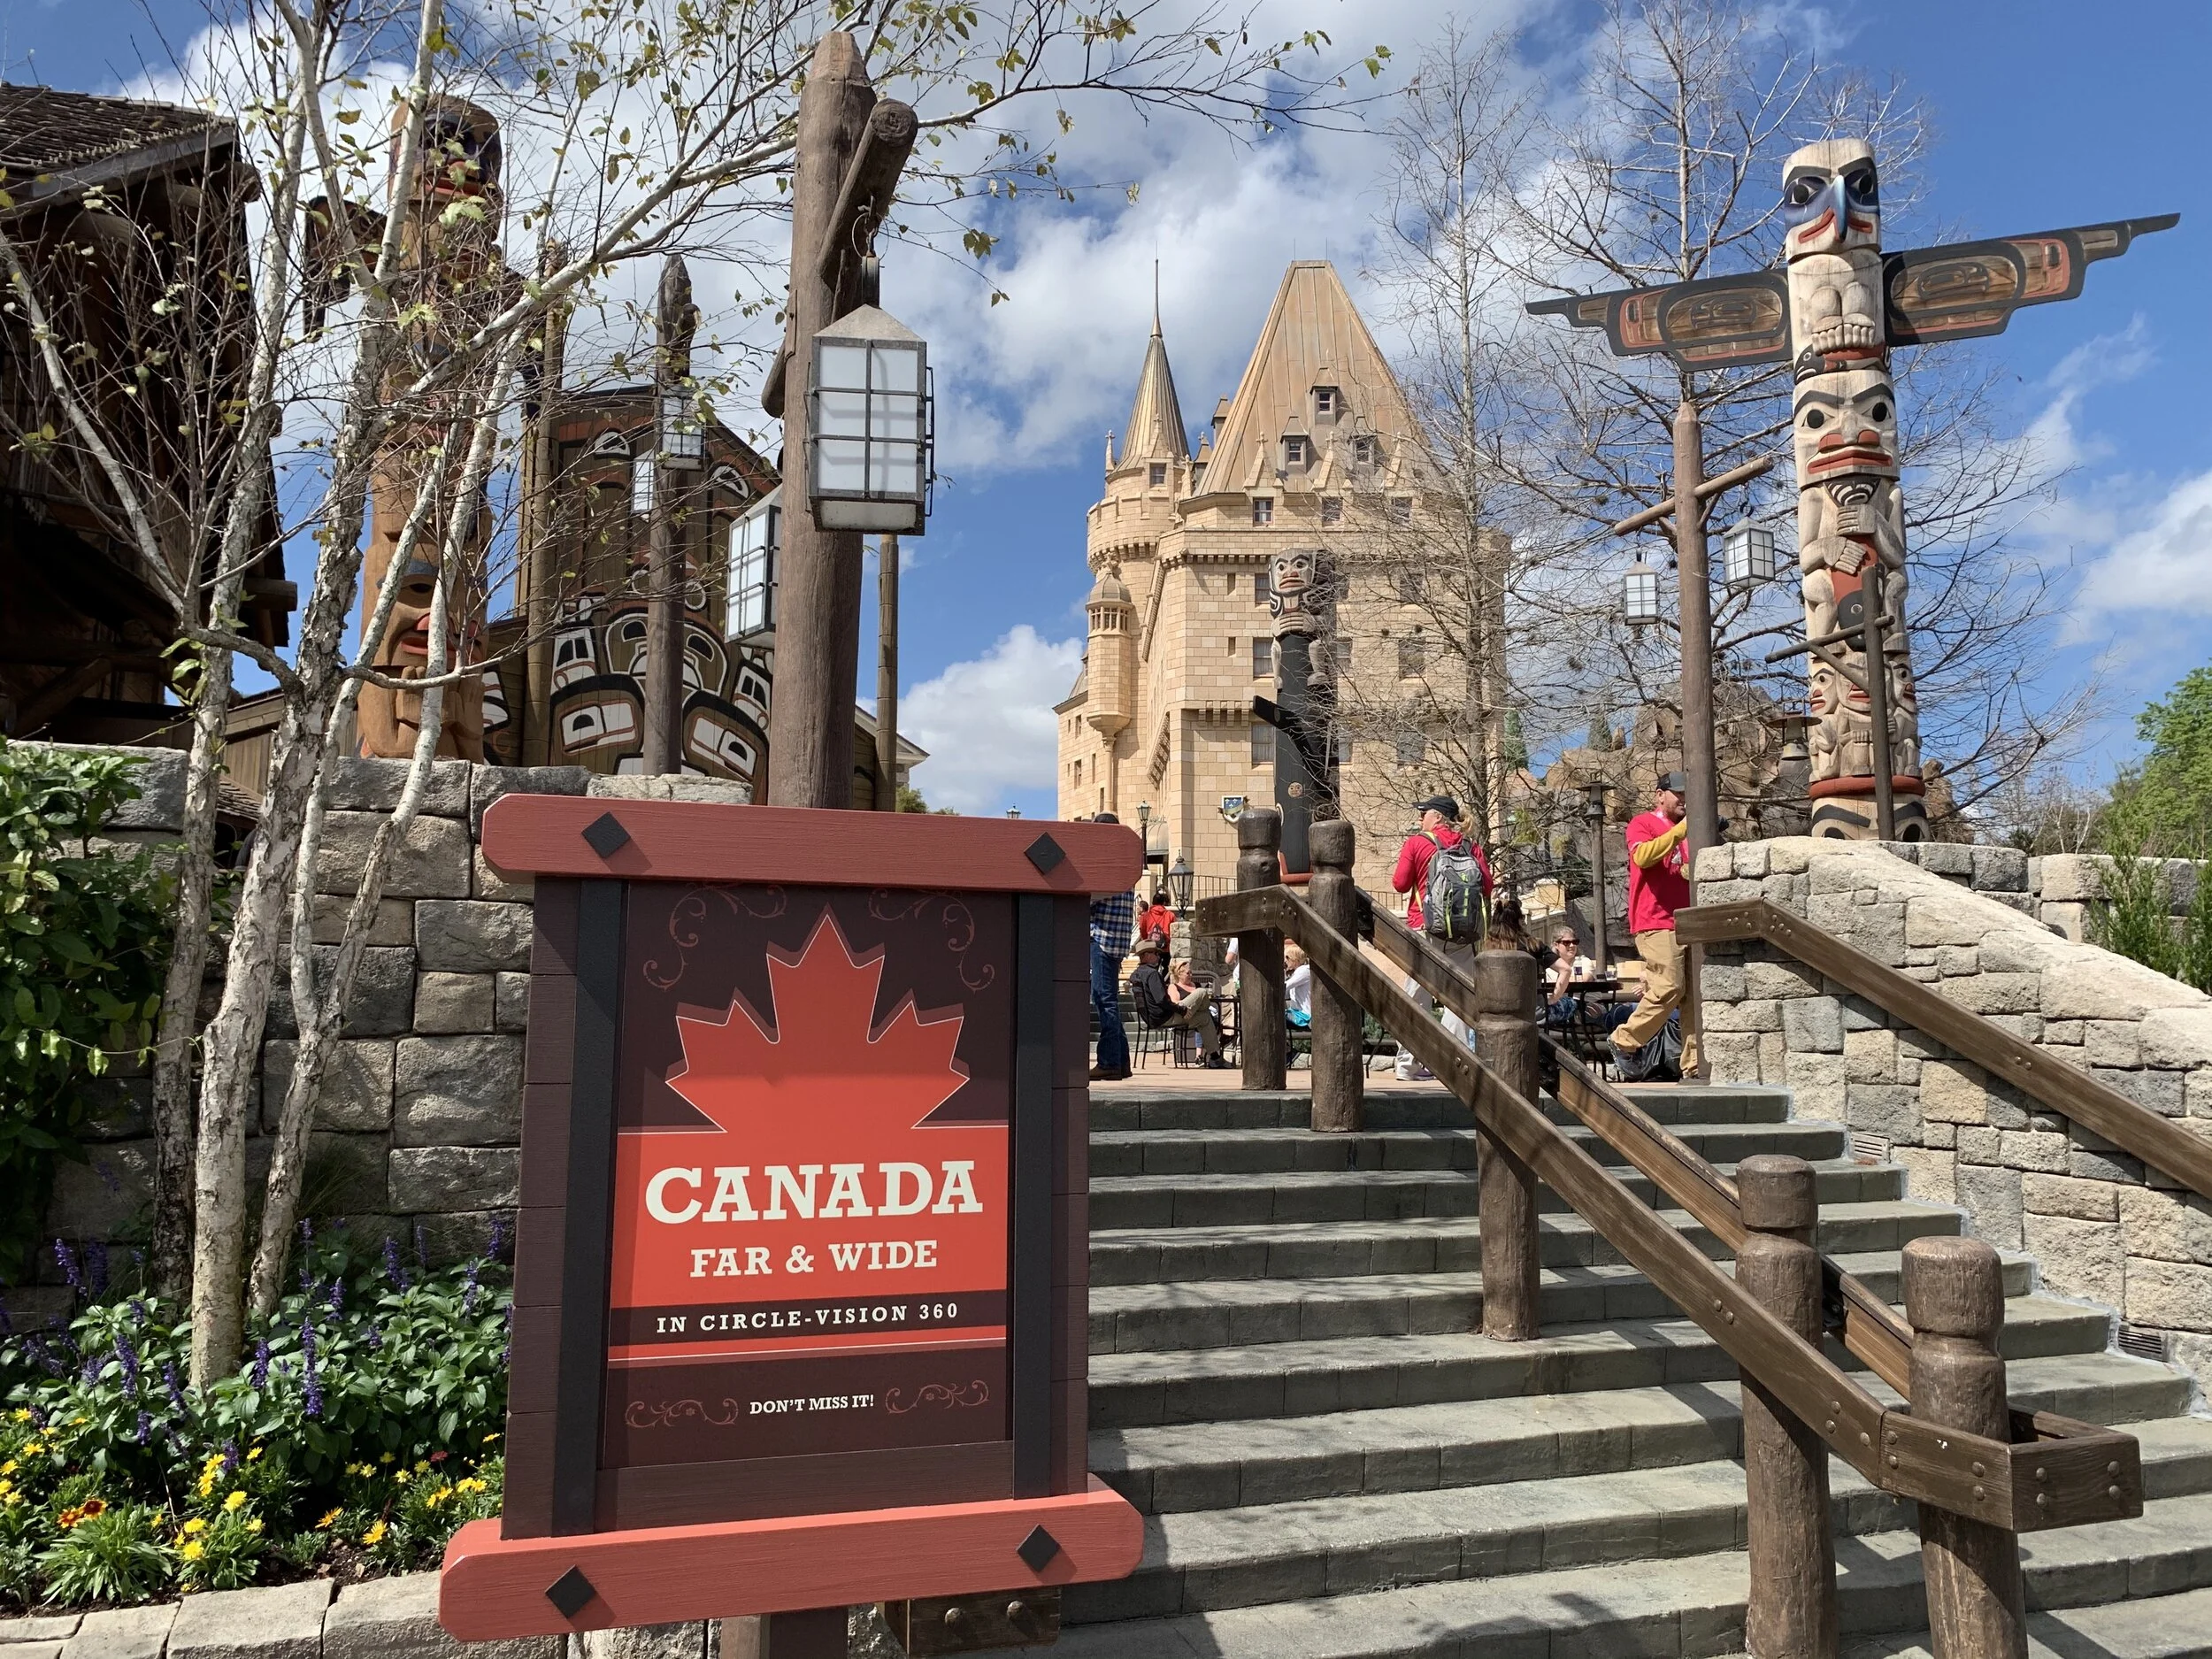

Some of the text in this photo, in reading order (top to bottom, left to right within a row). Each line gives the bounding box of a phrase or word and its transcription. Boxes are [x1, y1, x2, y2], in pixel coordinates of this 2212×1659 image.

[646, 1161, 982, 1224] CANADA
[691, 1240, 936, 1277] FAR & WIDE
[657, 1303, 956, 1333] IN CIRCLE-VISION 360
[750, 1394, 873, 1414] DON’T MISS IT!
